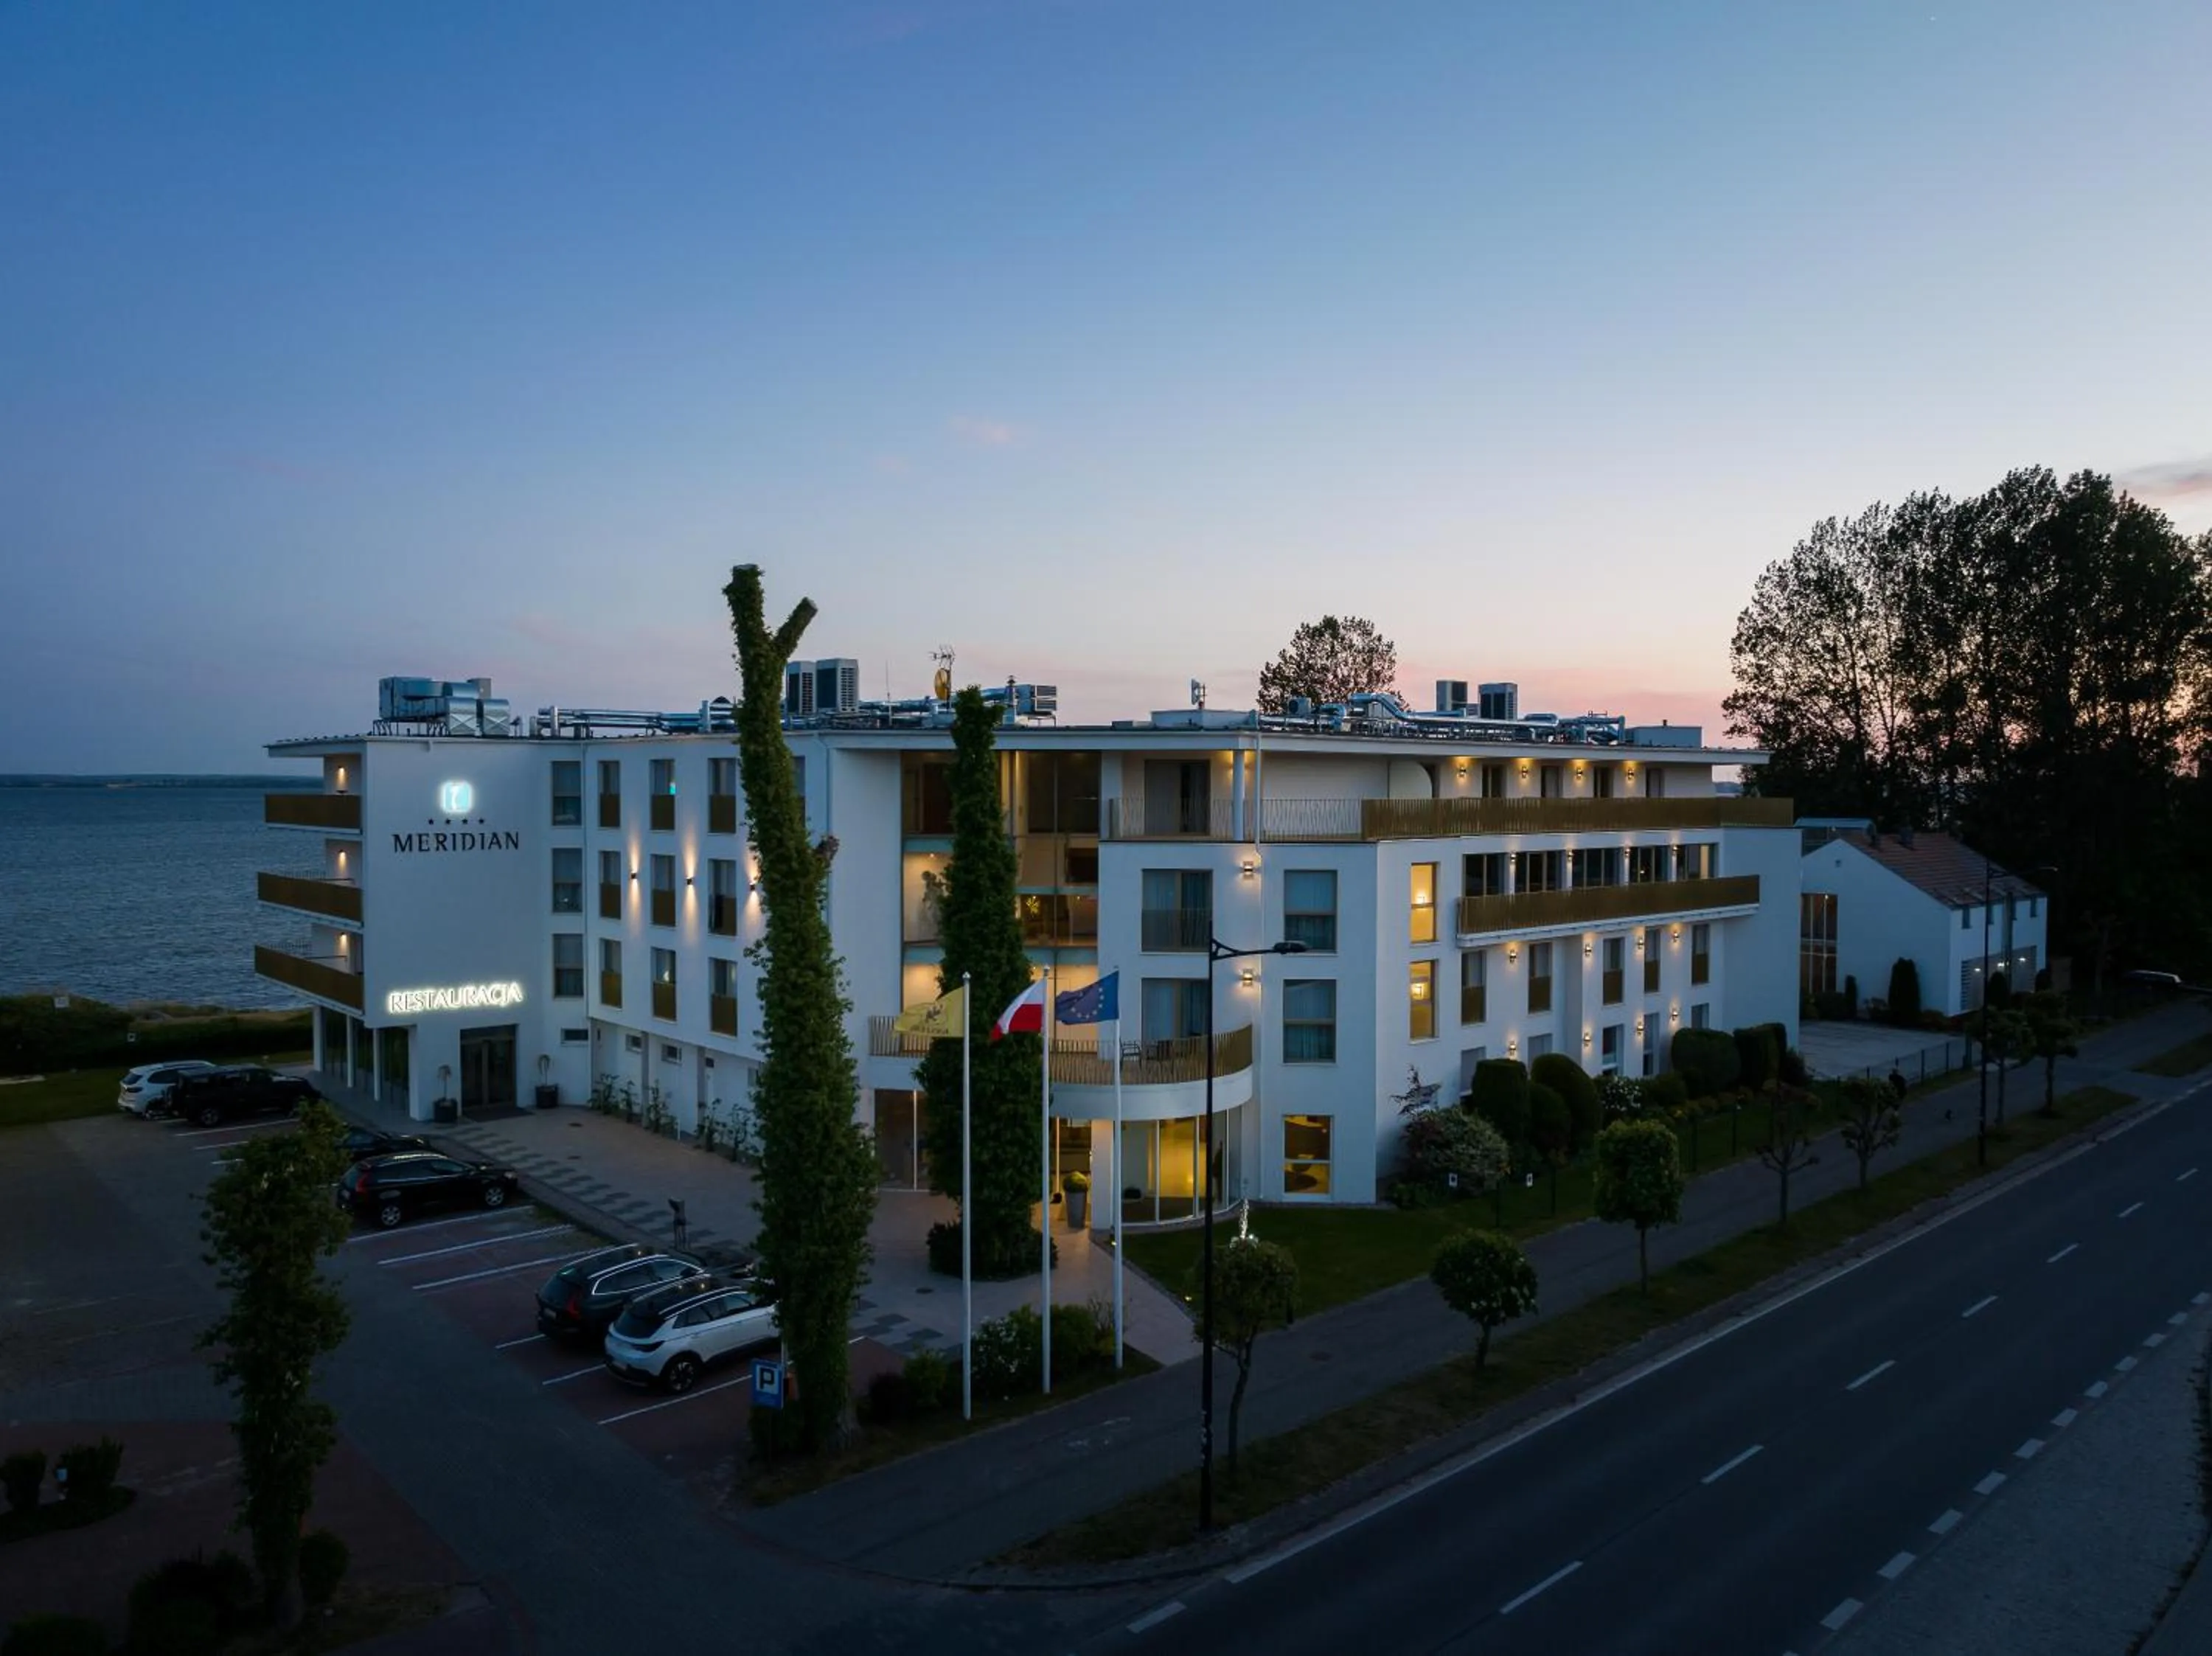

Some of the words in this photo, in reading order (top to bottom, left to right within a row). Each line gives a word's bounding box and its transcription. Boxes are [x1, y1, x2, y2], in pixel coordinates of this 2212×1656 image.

[392, 832, 519, 852] MERIDIAN
[389, 983, 523, 1013] RESTAURACJA
[759, 1368, 774, 1390] P
